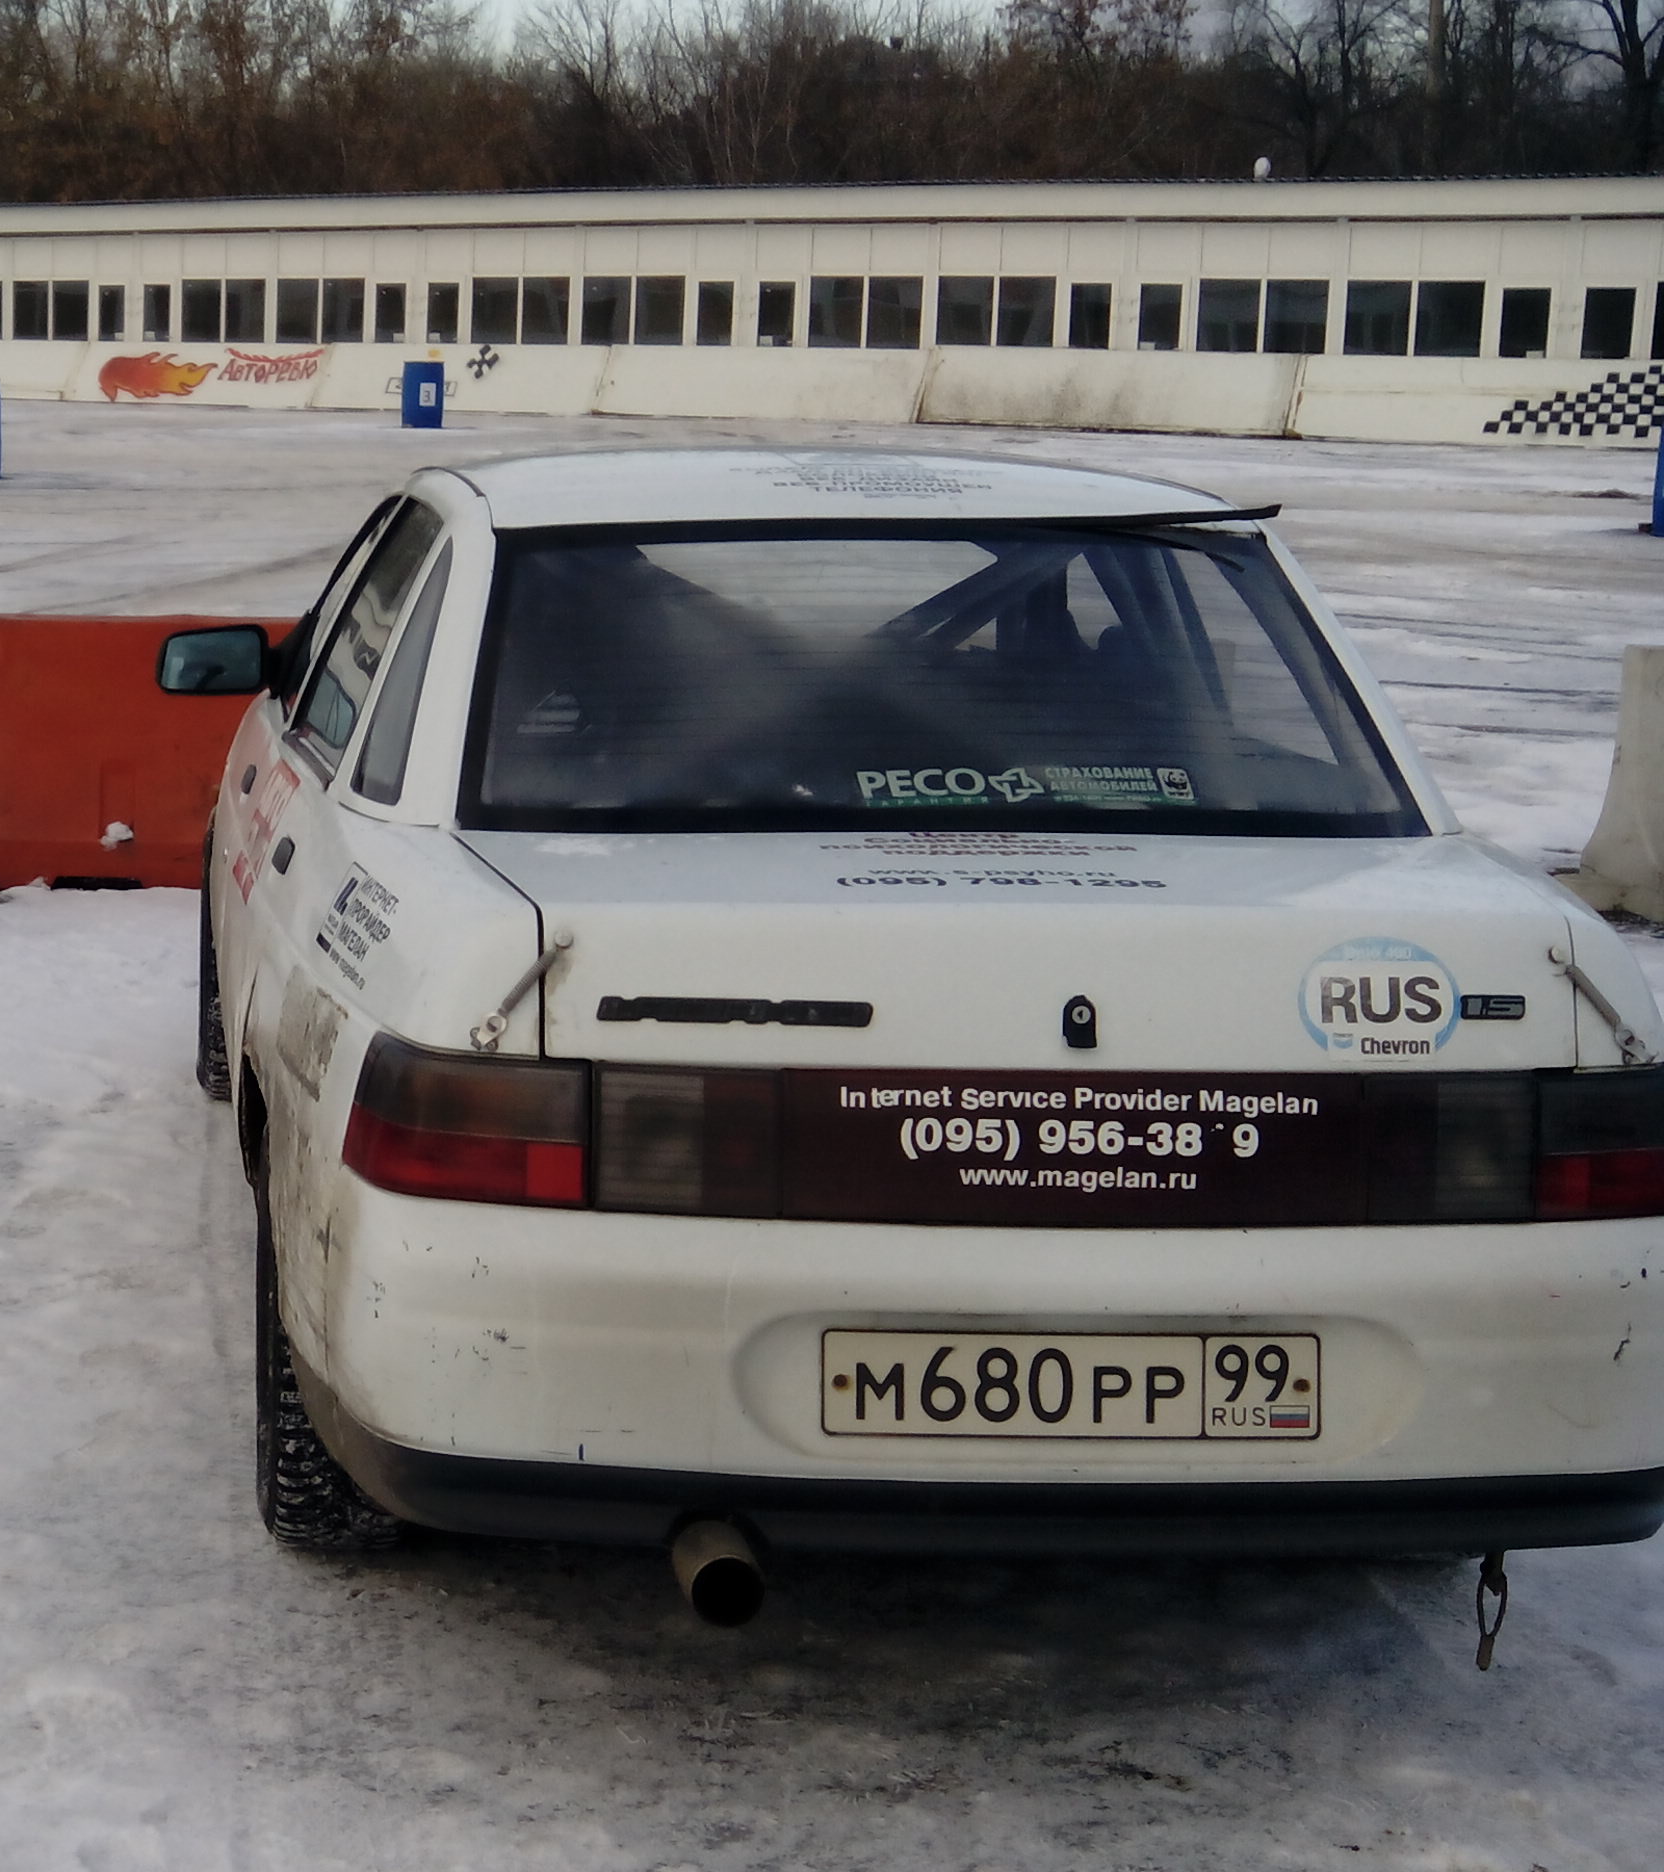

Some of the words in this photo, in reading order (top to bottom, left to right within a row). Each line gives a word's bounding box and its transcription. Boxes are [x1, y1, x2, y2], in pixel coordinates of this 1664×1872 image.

[423, 389, 432, 403] 3
[856, 767, 985, 798] РЕСО
[1044, 766, 1153, 780] СТРАХОВАНИЕ
[1049, 779, 1158, 792] АВТОМОБИЛЕЙ
[908, 831, 1019, 839] Центр
[836, 877, 948, 888] (095)
[1320, 976, 1442, 1024] RUS
[1360, 1037, 1430, 1055] Chevron
[960, 1088, 1067, 1110] Service
[1074, 1087, 1192, 1113] Provider
[1199, 1090, 1318, 1118] Magelan
[900, 1117, 1020, 1160] (095)
[1038, 1119, 1260, 1158] 956-389
[959, 1166, 1197, 1193] www.magelan.ru
[1214, 1344, 1290, 1403] 99
[1211, 1407, 1266, 1426] RUS
